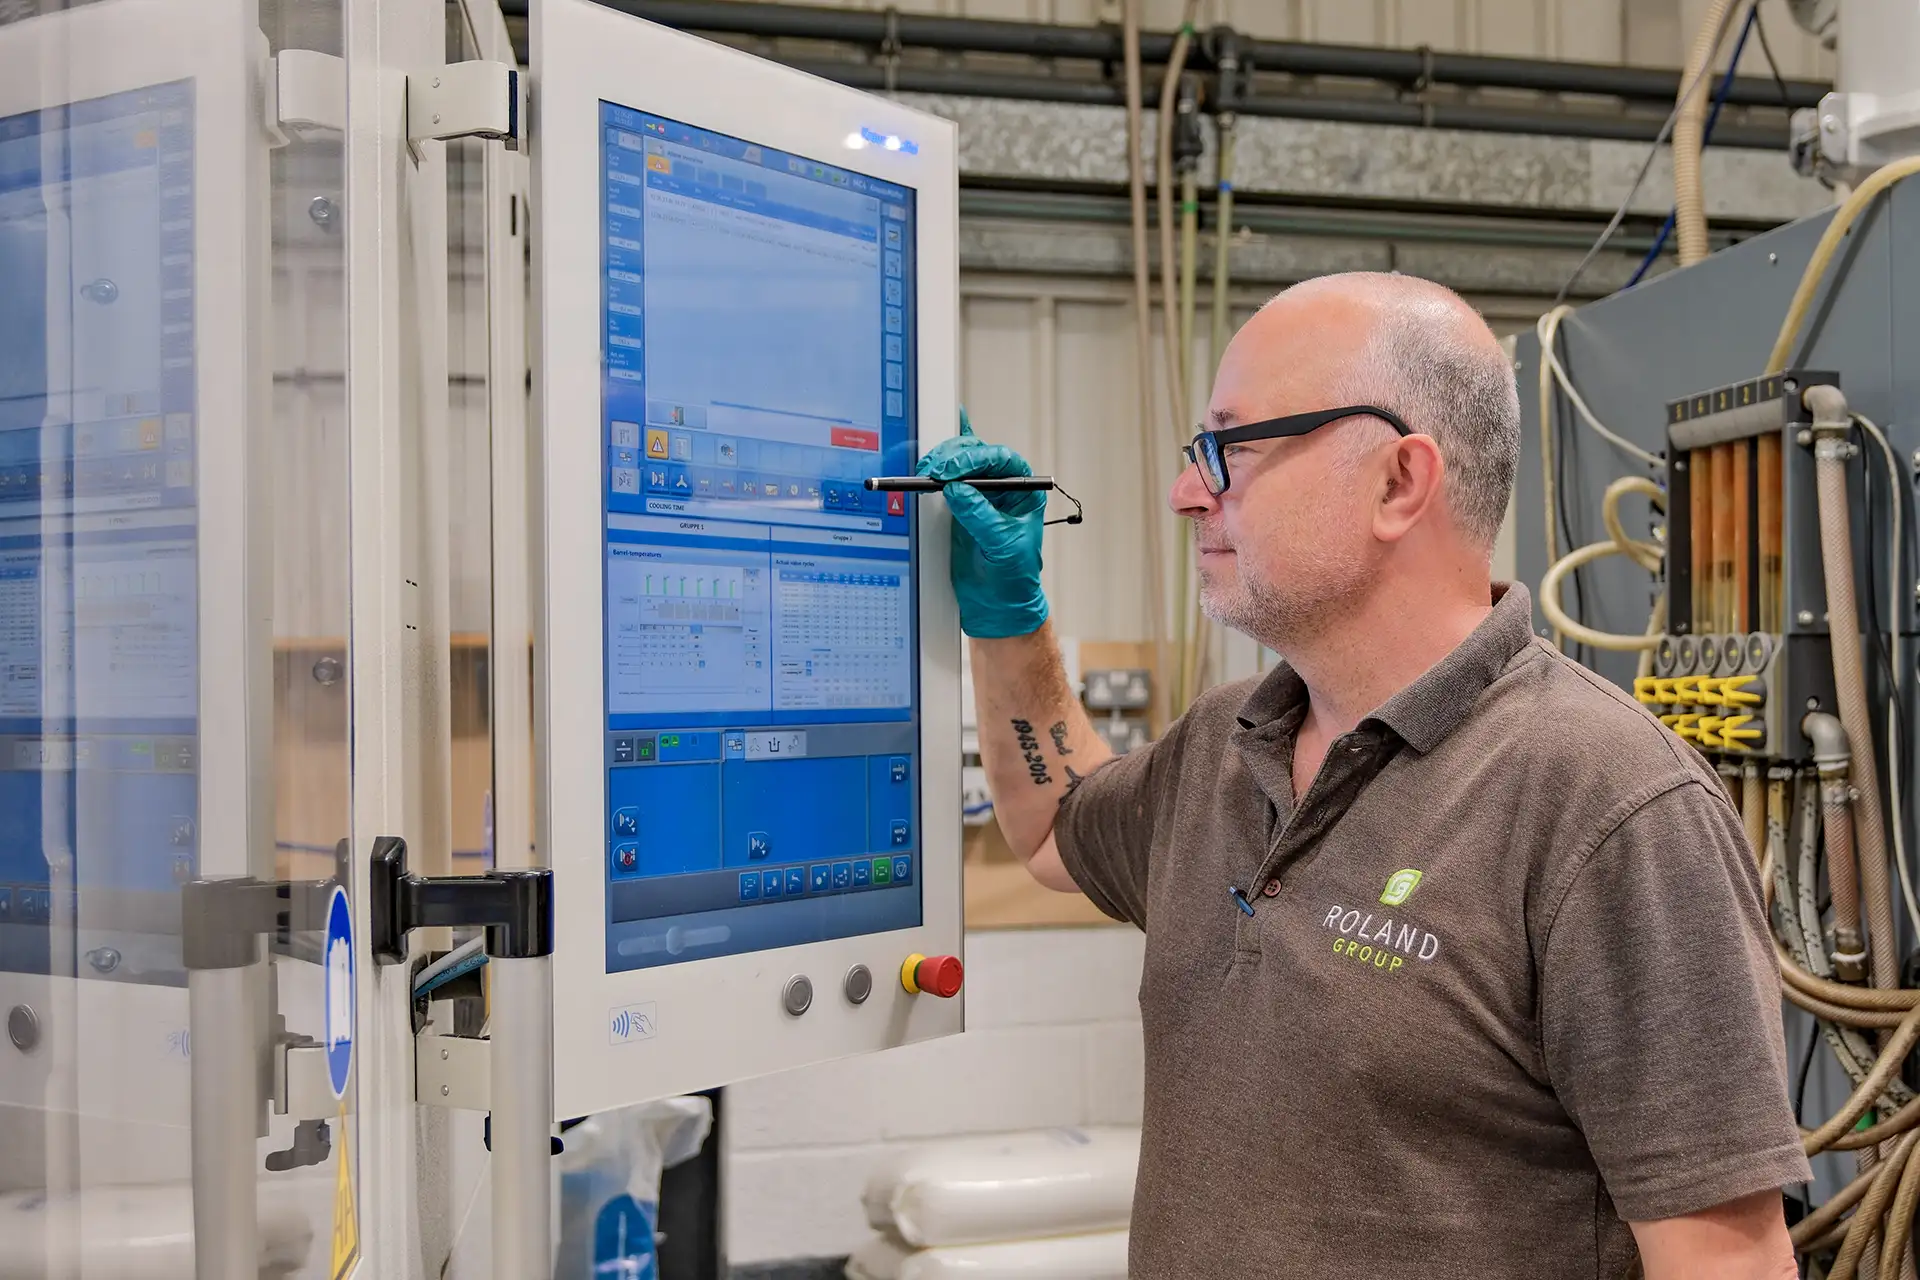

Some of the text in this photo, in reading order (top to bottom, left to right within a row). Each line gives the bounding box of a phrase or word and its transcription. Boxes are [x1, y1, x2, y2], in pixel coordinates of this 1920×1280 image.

[1743, 386, 1750, 405] 2
[1767, 380, 1775, 398] 1
[648, 502, 672, 510] COOLING
[679, 522, 700, 530] GRUPPE
[1322, 905, 1439, 960] ROLAND
[1332, 938, 1403, 971] GROUP
